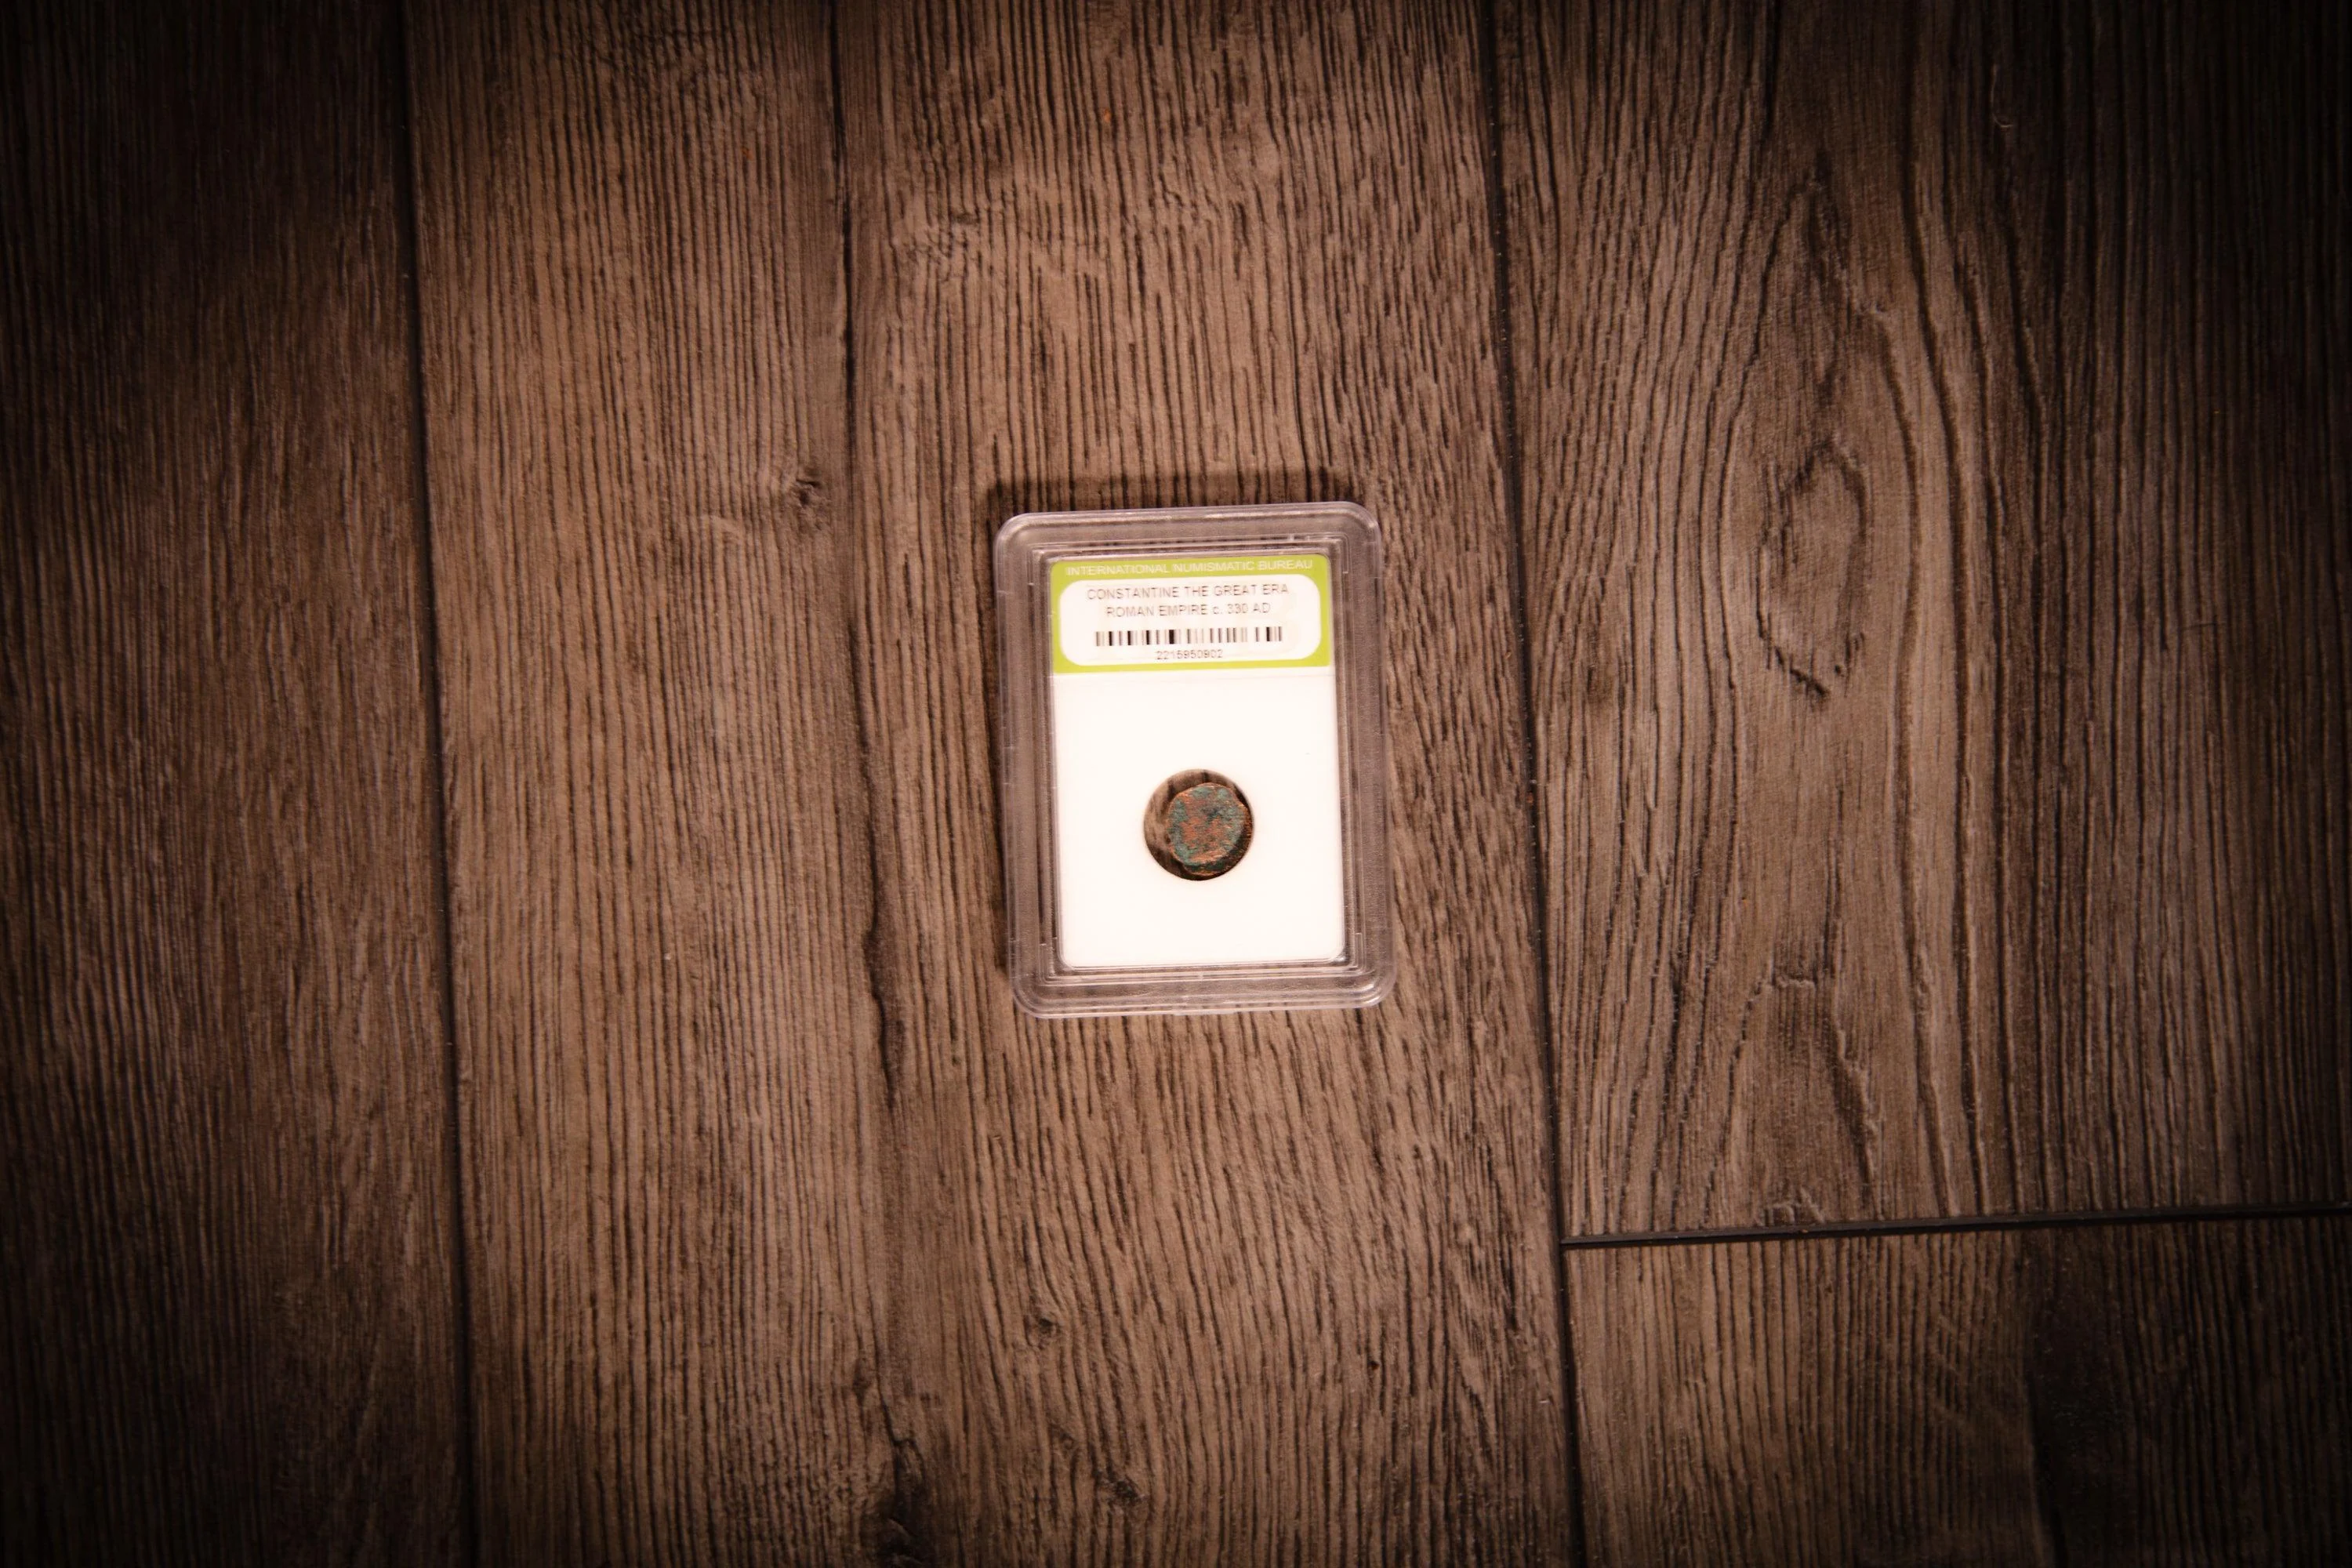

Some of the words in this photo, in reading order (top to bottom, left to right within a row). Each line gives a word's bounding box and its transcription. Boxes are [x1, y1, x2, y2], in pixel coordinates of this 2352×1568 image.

[1066, 564, 1170, 575] INTERNATIONAL
[1173, 561, 1254, 572] NUMISMATIC
[1258, 559, 1312, 570] BUREAU
[1087, 586, 1179, 600] CONSTANTINE
[1184, 586, 1208, 597] THE
[1214, 584, 1258, 596] GREAT
[1262, 583, 1289, 595] ERA
[1106, 606, 1155, 617] ROMAN
[1159, 604, 1207, 616] EMPIRE
[1213, 605, 1223, 615] c.
[1227, 603, 1249, 614] 330
[1253, 602, 1271, 613] AD
